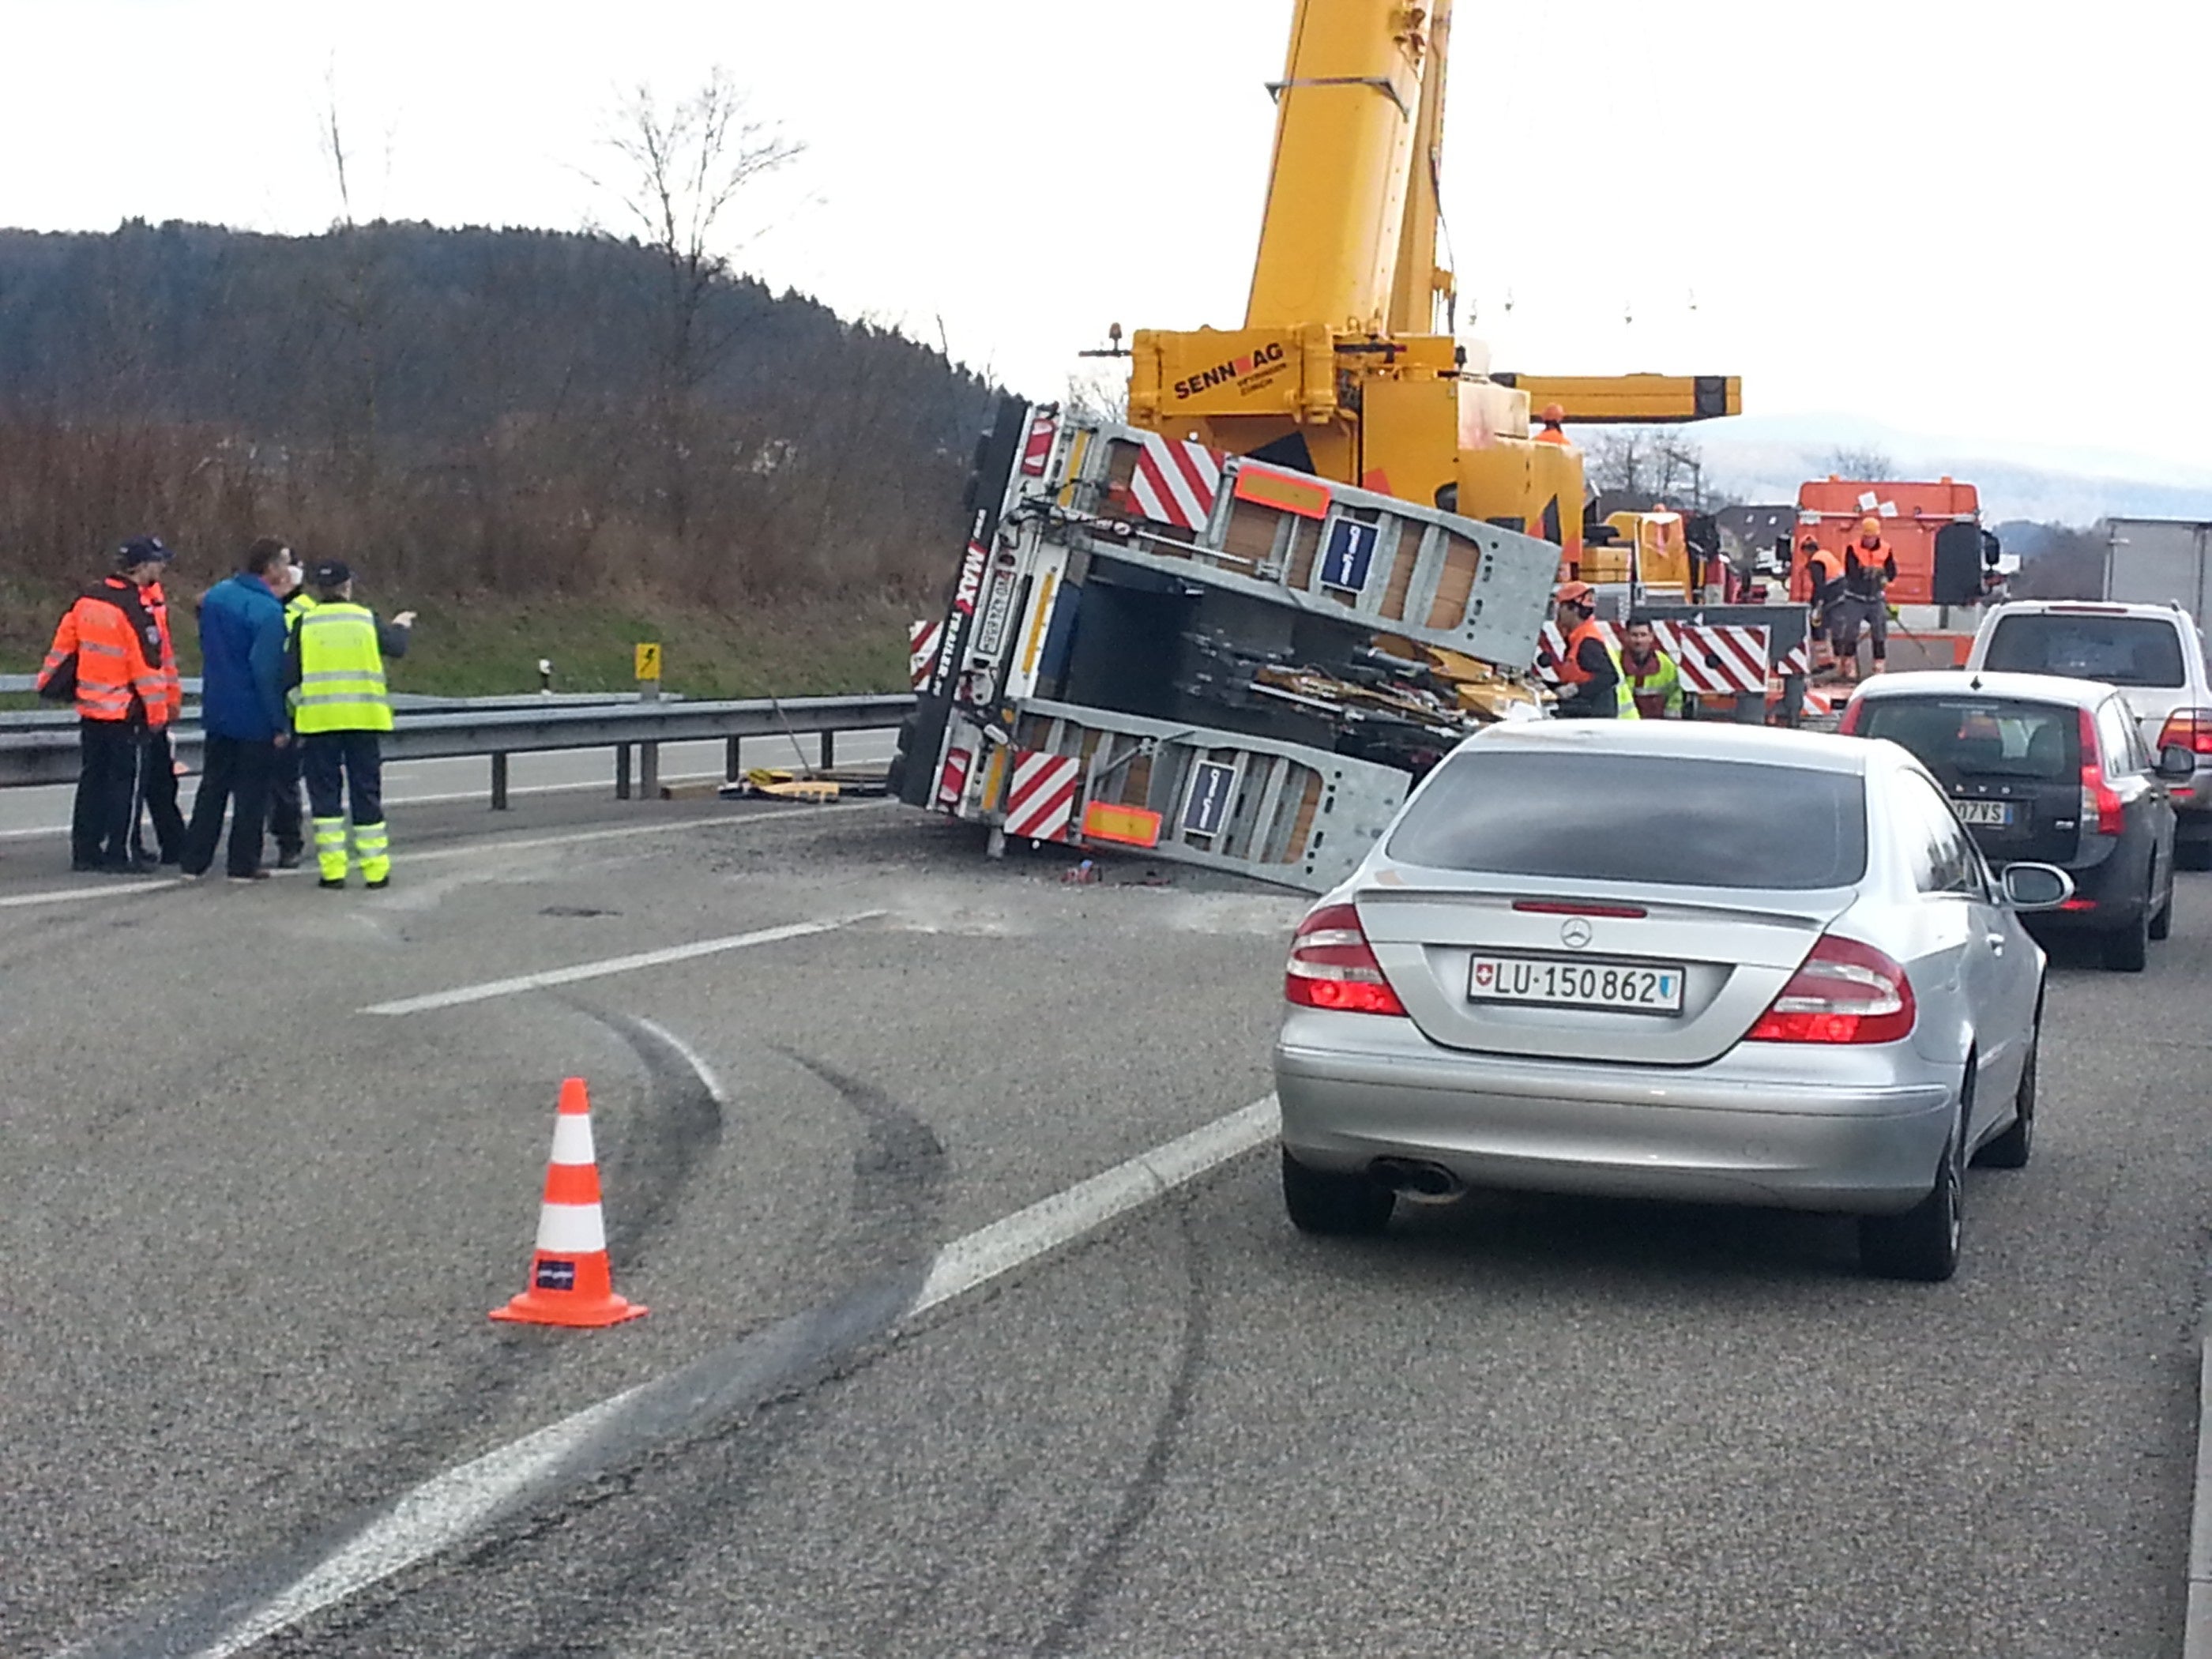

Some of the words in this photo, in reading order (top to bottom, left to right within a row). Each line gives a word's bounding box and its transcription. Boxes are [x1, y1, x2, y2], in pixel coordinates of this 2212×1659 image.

[1174, 360, 1237, 400] SENN
[1253, 342, 1284, 368] AG
[1956, 800, 2003, 822] 07VS
